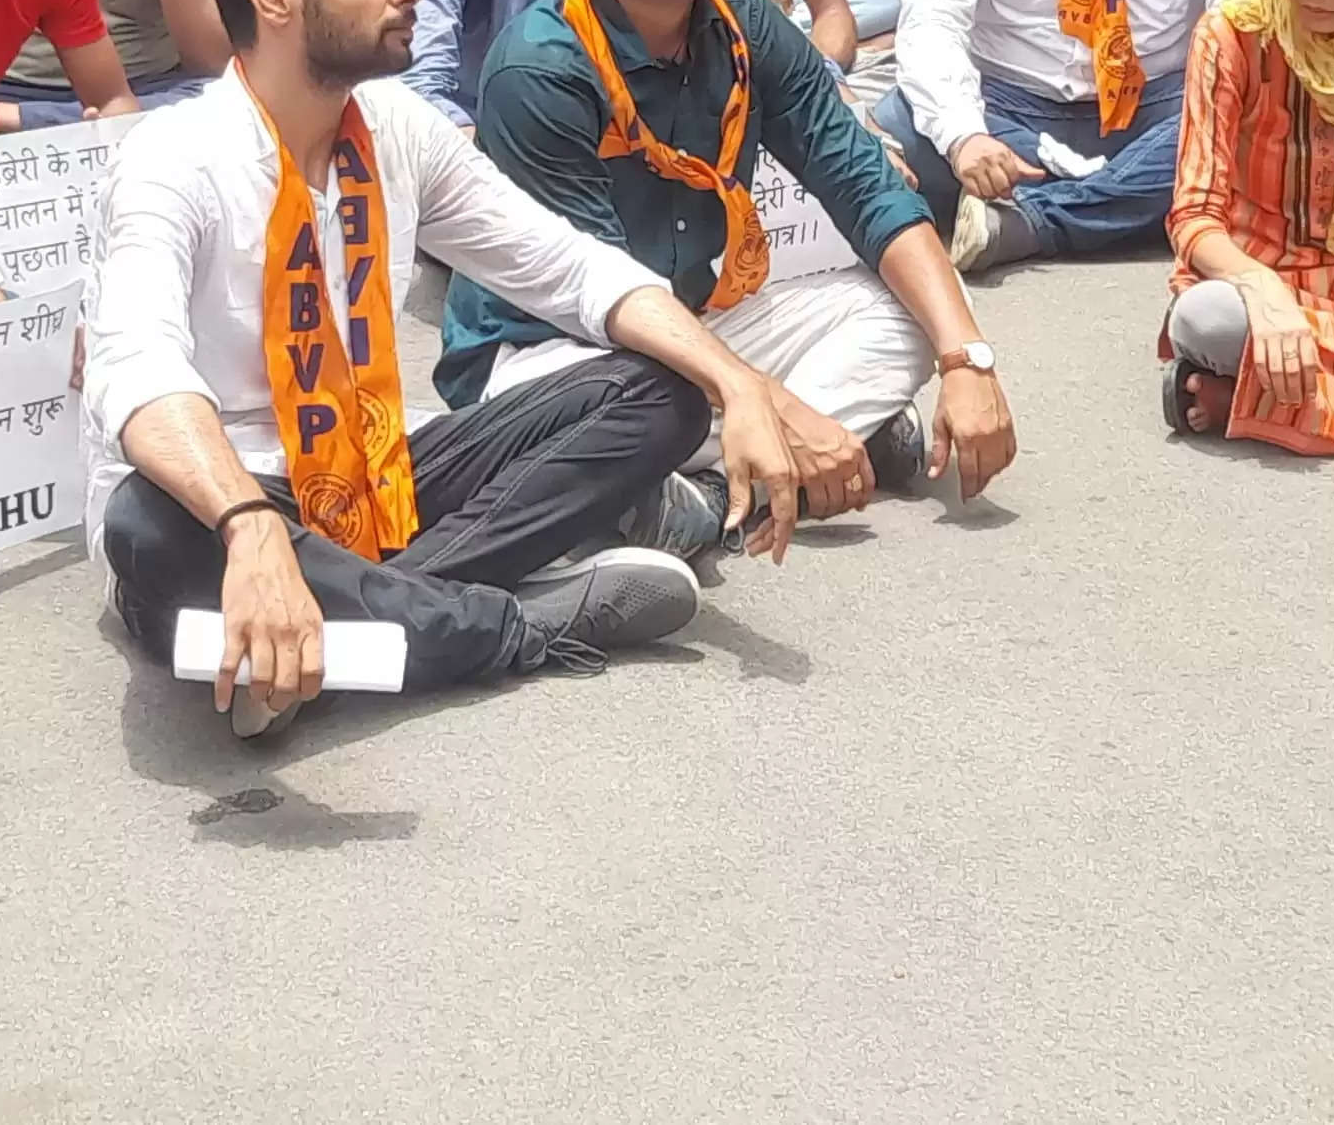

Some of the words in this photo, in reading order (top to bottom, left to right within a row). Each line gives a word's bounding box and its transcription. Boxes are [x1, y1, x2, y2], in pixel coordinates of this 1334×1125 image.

[46, 144, 70, 176] के
[77, 145, 110, 171] नए
[64, 185, 84, 217] में
[3, 241, 69, 282] पूछता
[75, 223, 91, 264] है
[20, 304, 67, 341] शीघ्र
[286, 221, 337, 455] ABVP
[22, 394, 66, 436] शुरू
